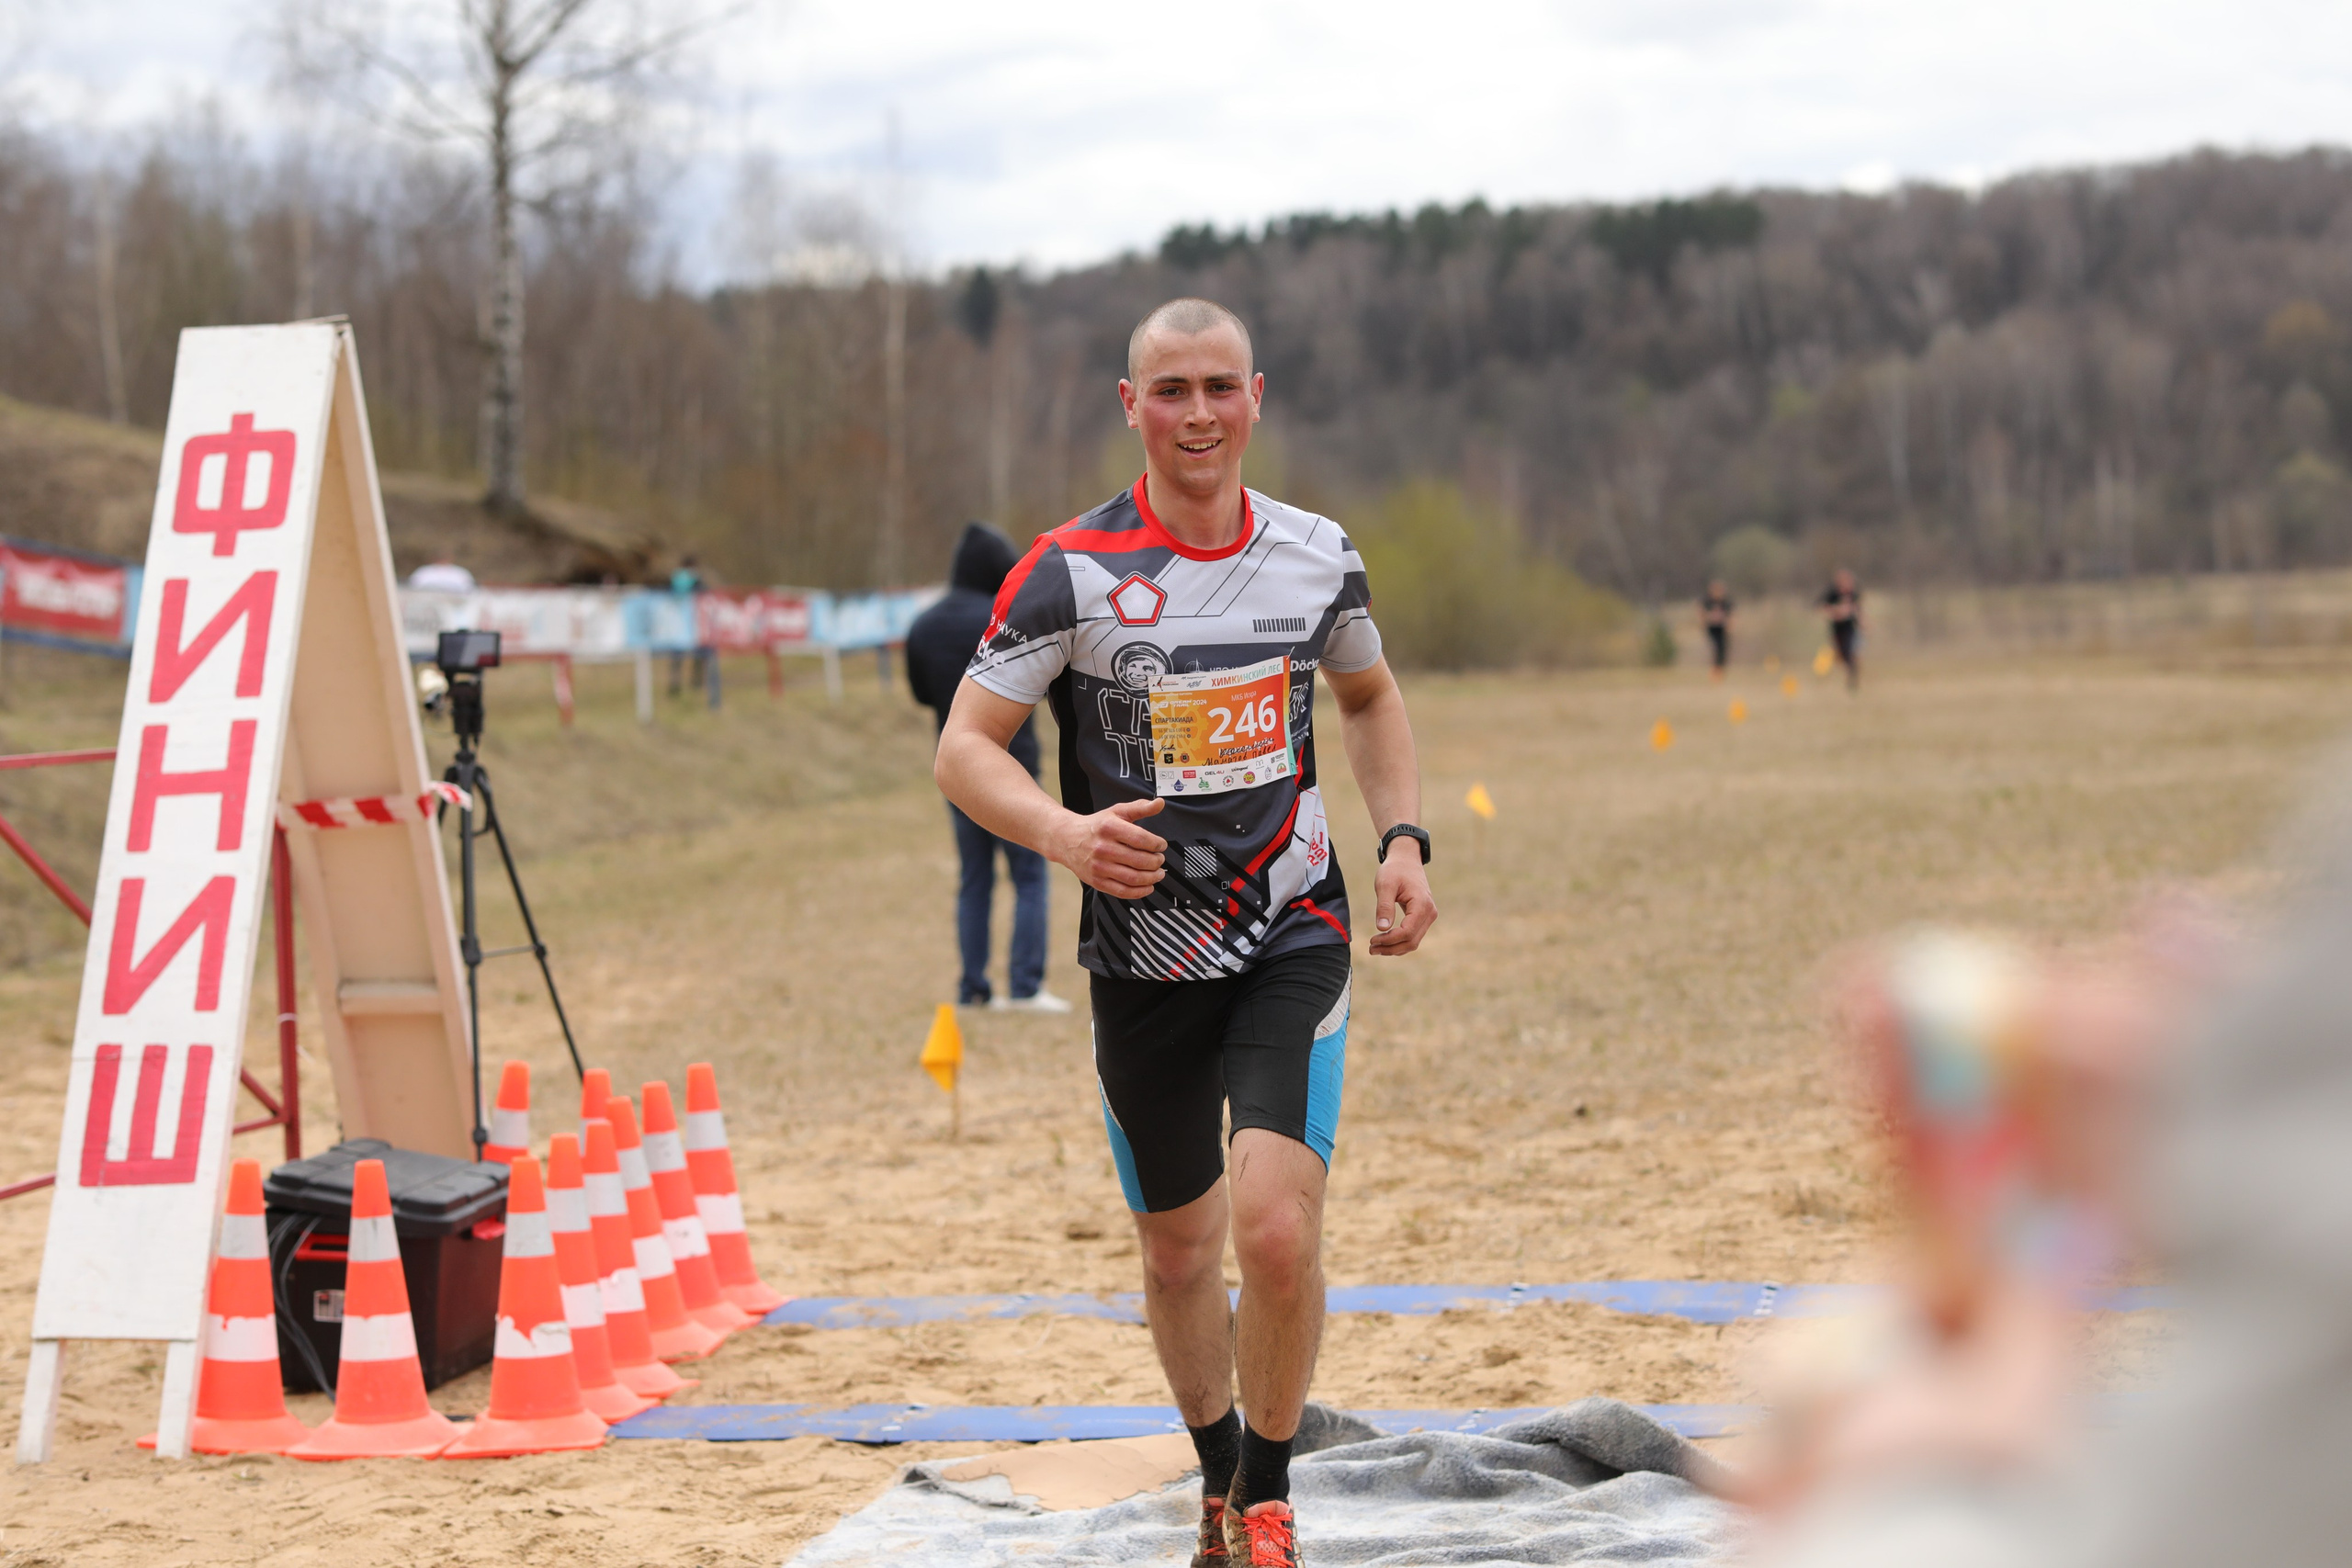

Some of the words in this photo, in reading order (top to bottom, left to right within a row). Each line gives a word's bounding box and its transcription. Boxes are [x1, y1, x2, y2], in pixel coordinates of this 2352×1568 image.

[1211, 666, 1266, 687] ХИМКИНСКИЙ
[1268, 663, 1282, 675] ЛЕС
[1207, 694, 1277, 744] 246
[79, 412, 297, 1187] ФИНИШ
